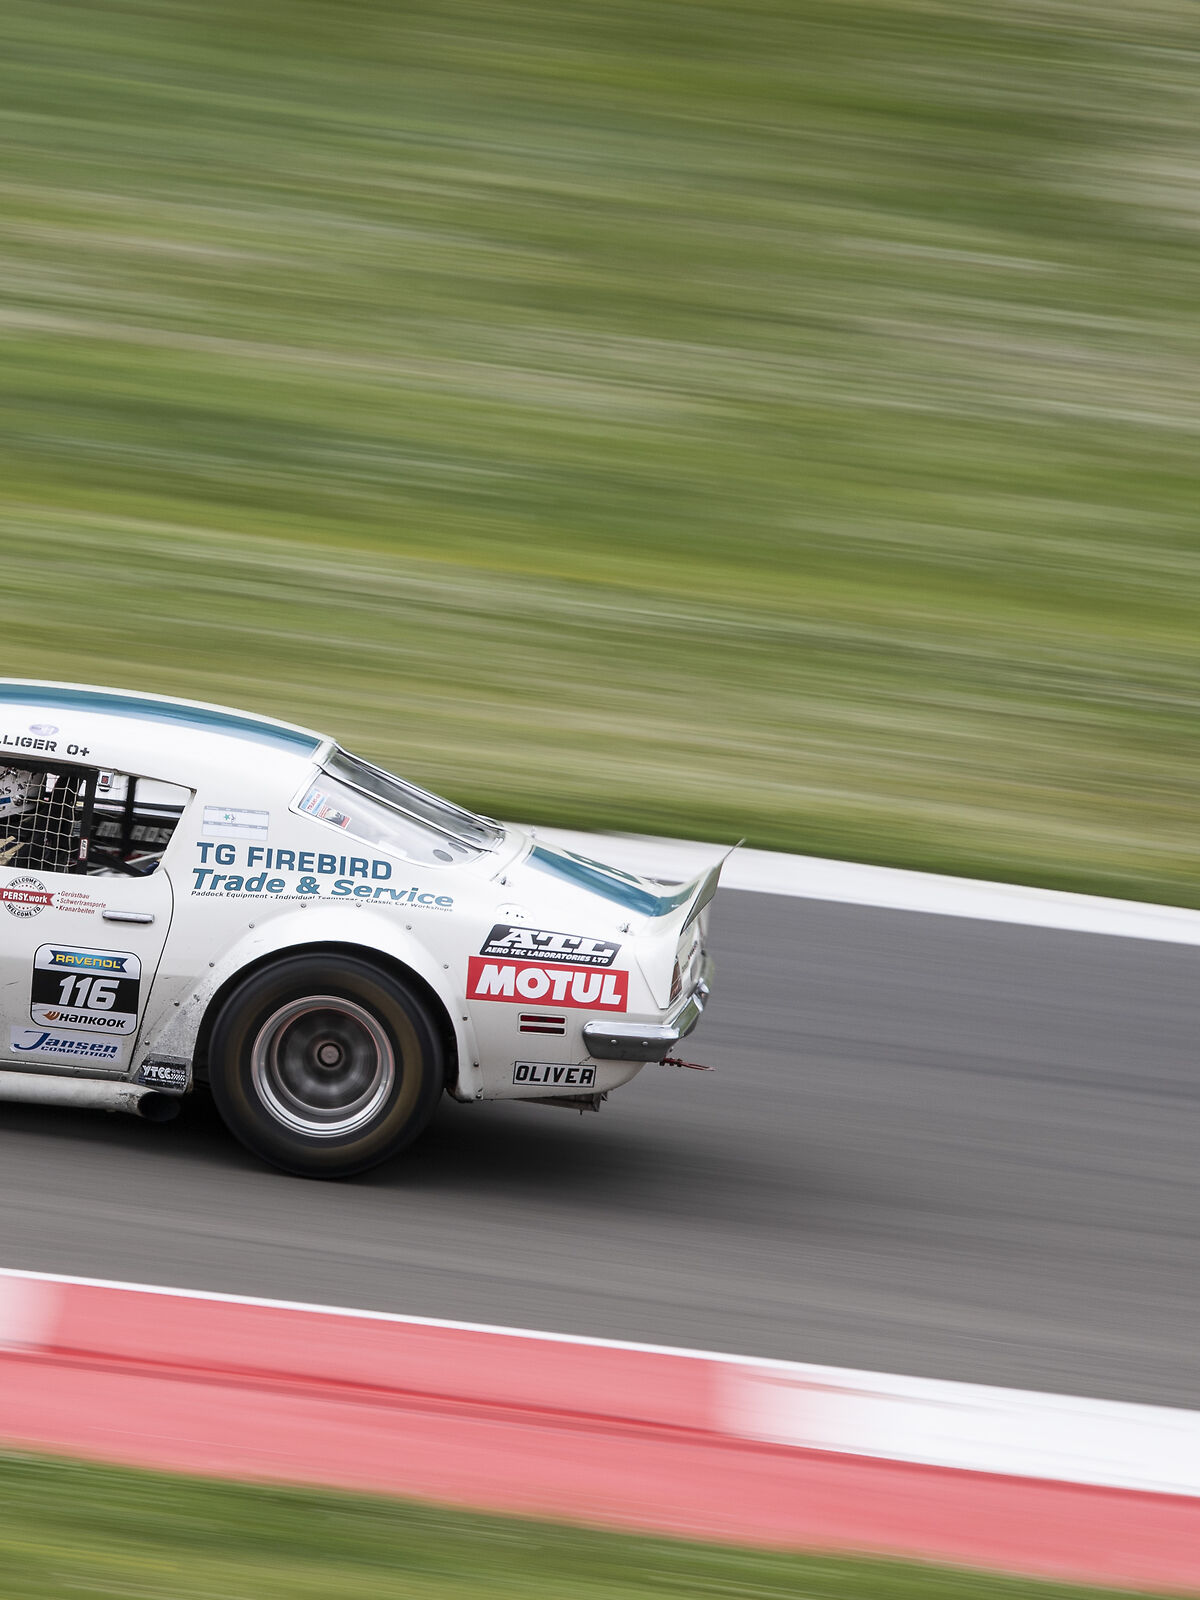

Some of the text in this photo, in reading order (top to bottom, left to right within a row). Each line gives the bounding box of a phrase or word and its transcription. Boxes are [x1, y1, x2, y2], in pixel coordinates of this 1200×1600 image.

[196, 842, 393, 880] TG FIREBIRD
[10, 877, 44, 891] WELCOME TO
[192, 868, 455, 908] Trade & Service
[2, 890, 48, 904] PERSY.work
[191, 890, 224, 899] Paddock
[225, 892, 268, 901] Equipment
[275, 893, 315, 901] Individual
[6, 903, 41, 917] WELCOME TO
[58, 906, 96, 915] Kranarbeiten
[489, 927, 615, 957] ATL
[55, 953, 121, 969] RAVENOL
[484, 946, 609, 964] AERO TEC LABORATORIES LTD
[58, 974, 120, 1010] 116
[475, 964, 622, 1005] MOTUL
[13, 1030, 118, 1054] Jansen
[41, 1046, 116, 1059] COMPETITION
[142, 1064, 171, 1080] YTCC
[515, 1065, 594, 1085] OLIVER
